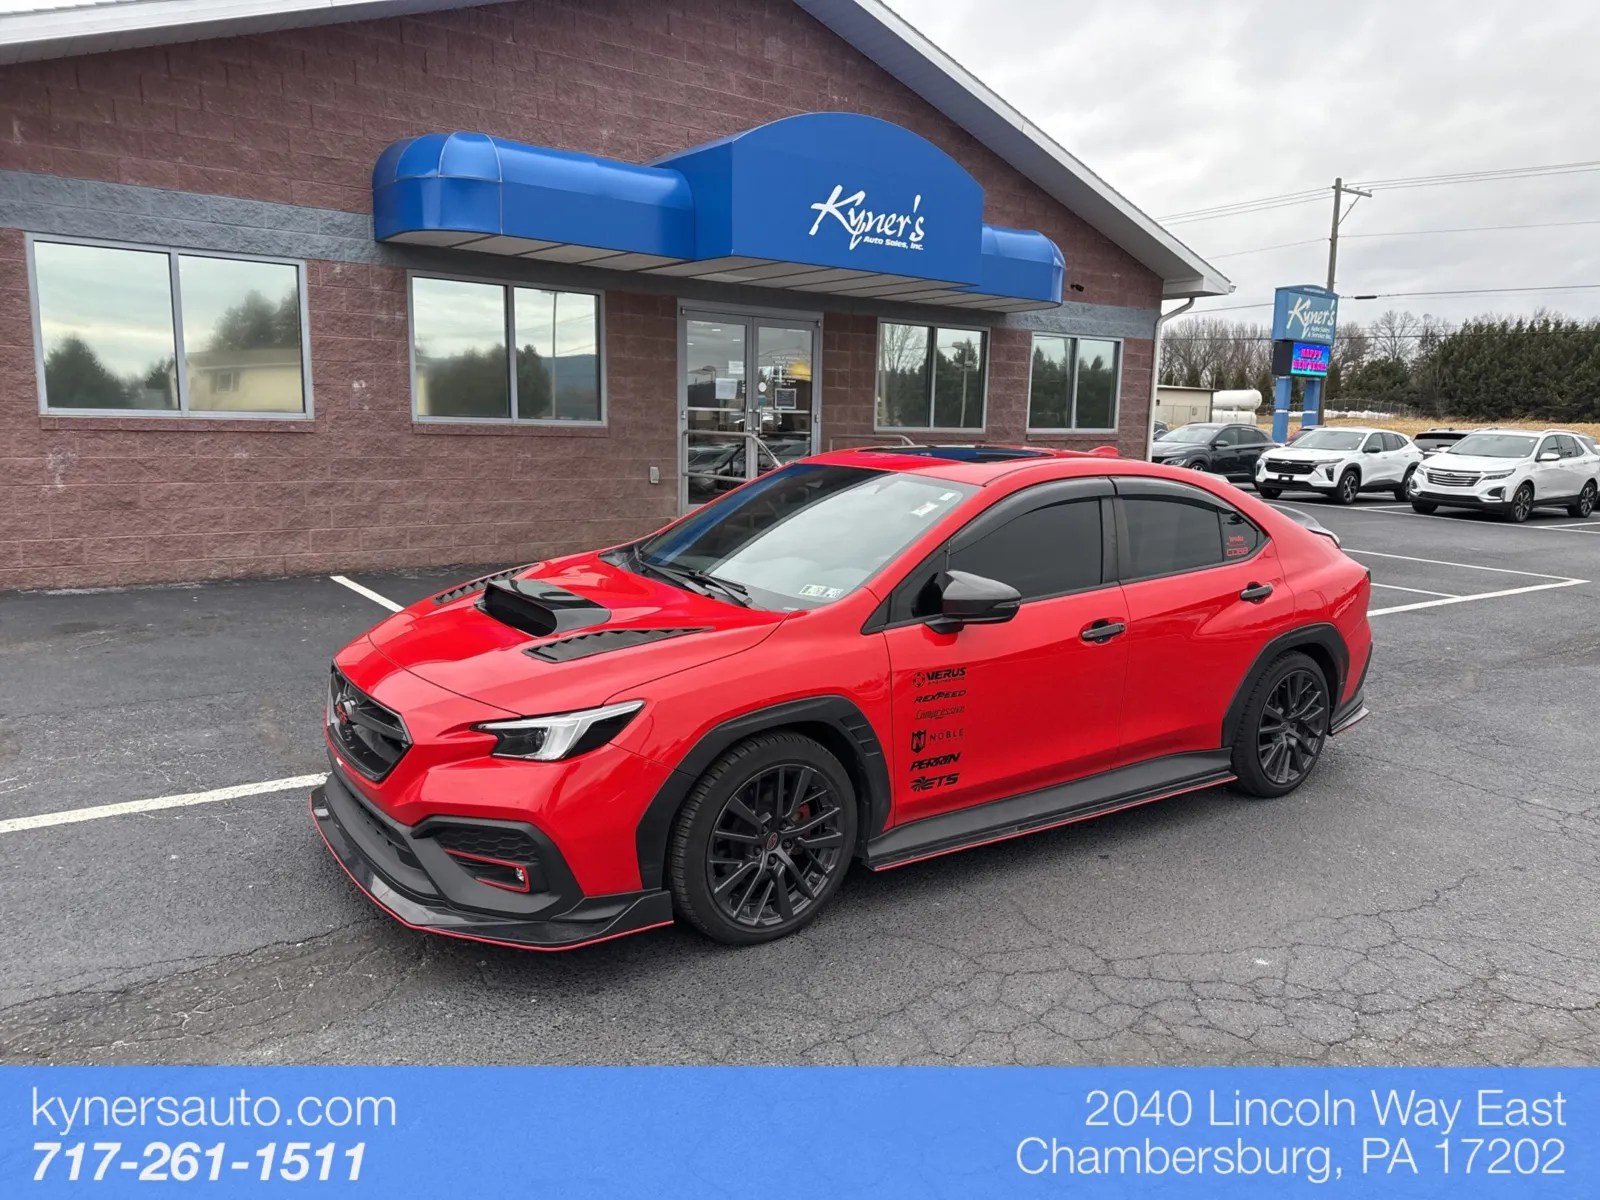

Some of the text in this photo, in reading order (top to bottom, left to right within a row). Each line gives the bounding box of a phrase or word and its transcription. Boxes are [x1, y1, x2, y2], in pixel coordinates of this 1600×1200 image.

[808, 184, 925, 250] Kyner's
[863, 235, 924, 250] Auto Sales, Inc.
[1287, 296, 1335, 339] Kyner's
[926, 667, 966, 680] VERUS
[915, 690, 966, 703] REXPEED
[929, 729, 964, 741] NOBLE
[910, 752, 961, 771] PERRIN
